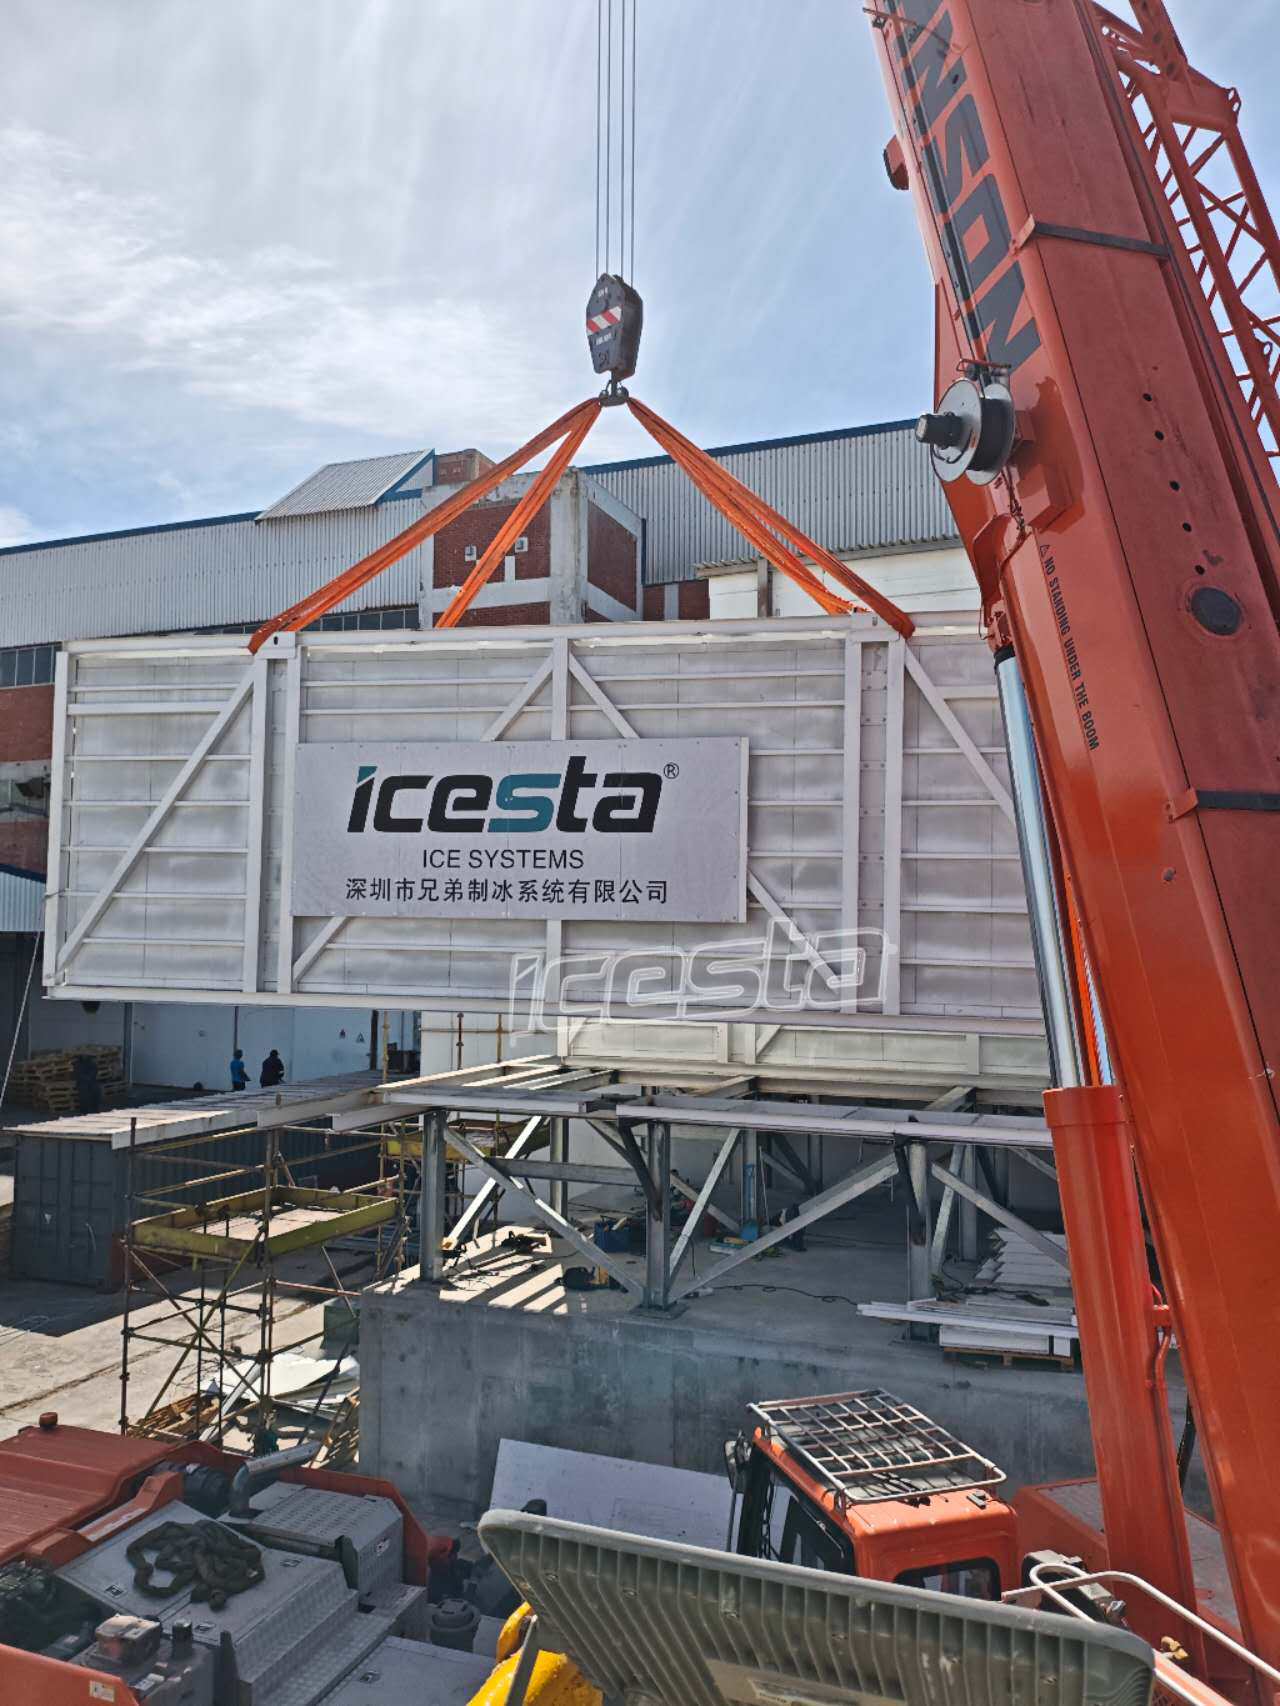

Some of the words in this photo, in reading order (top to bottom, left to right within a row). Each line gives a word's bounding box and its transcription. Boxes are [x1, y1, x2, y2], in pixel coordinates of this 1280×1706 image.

[1044, 556, 1056, 576] NO
[1049, 577, 1070, 636] STANDING
[1063, 637, 1082, 681] UNDER
[1074, 681, 1090, 709] THE
[1081, 710, 1100, 751] BOOM
[422, 849, 461, 869] ICE
[468, 849, 585, 870] SYSTEMS
[345, 877, 668, 905] 深圳市兄弟制冰系统有限公司
